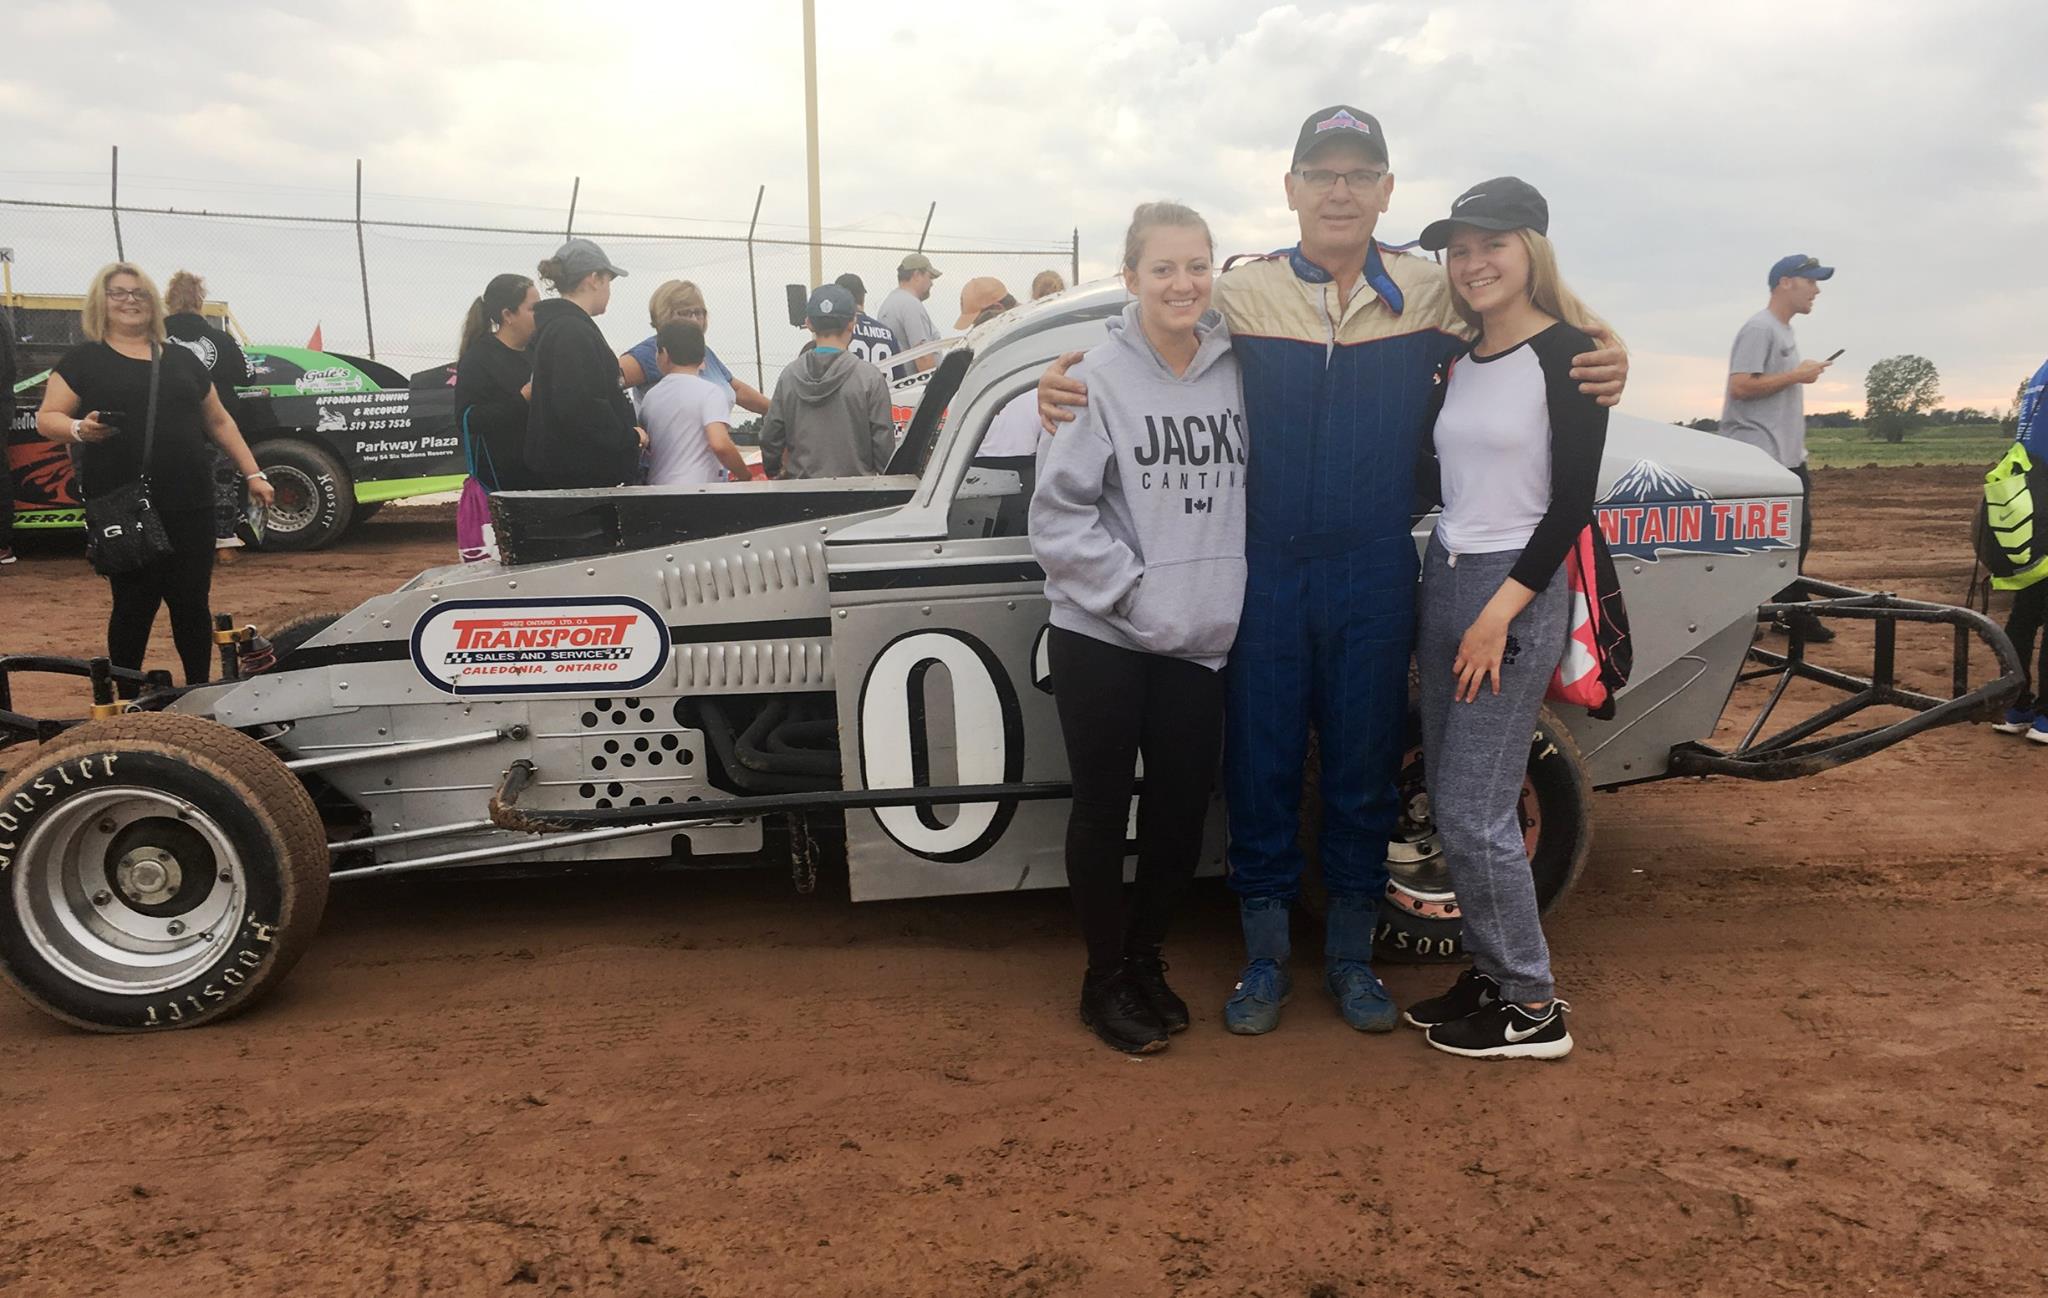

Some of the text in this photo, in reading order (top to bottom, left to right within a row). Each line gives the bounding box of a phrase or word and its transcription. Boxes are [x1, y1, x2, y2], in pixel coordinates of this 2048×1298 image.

[853, 323, 893, 341] LANDER
[305, 367, 349, 382] Gale's
[316, 392, 410, 405] AFFORDABLE TOWING
[363, 405, 409, 416] RECOVERY
[349, 419, 411, 431] 519 755 7526
[356, 436, 459, 453] Parkway Plaza
[1134, 408, 1246, 466] JACK'S
[1593, 500, 1791, 545] NTAIN TIRE
[453, 615, 638, 649] TRANSPORT
[475, 650, 605, 662] SALES AND SERVICE
[462, 662, 618, 676] CALEDONIA, ONTARIO
